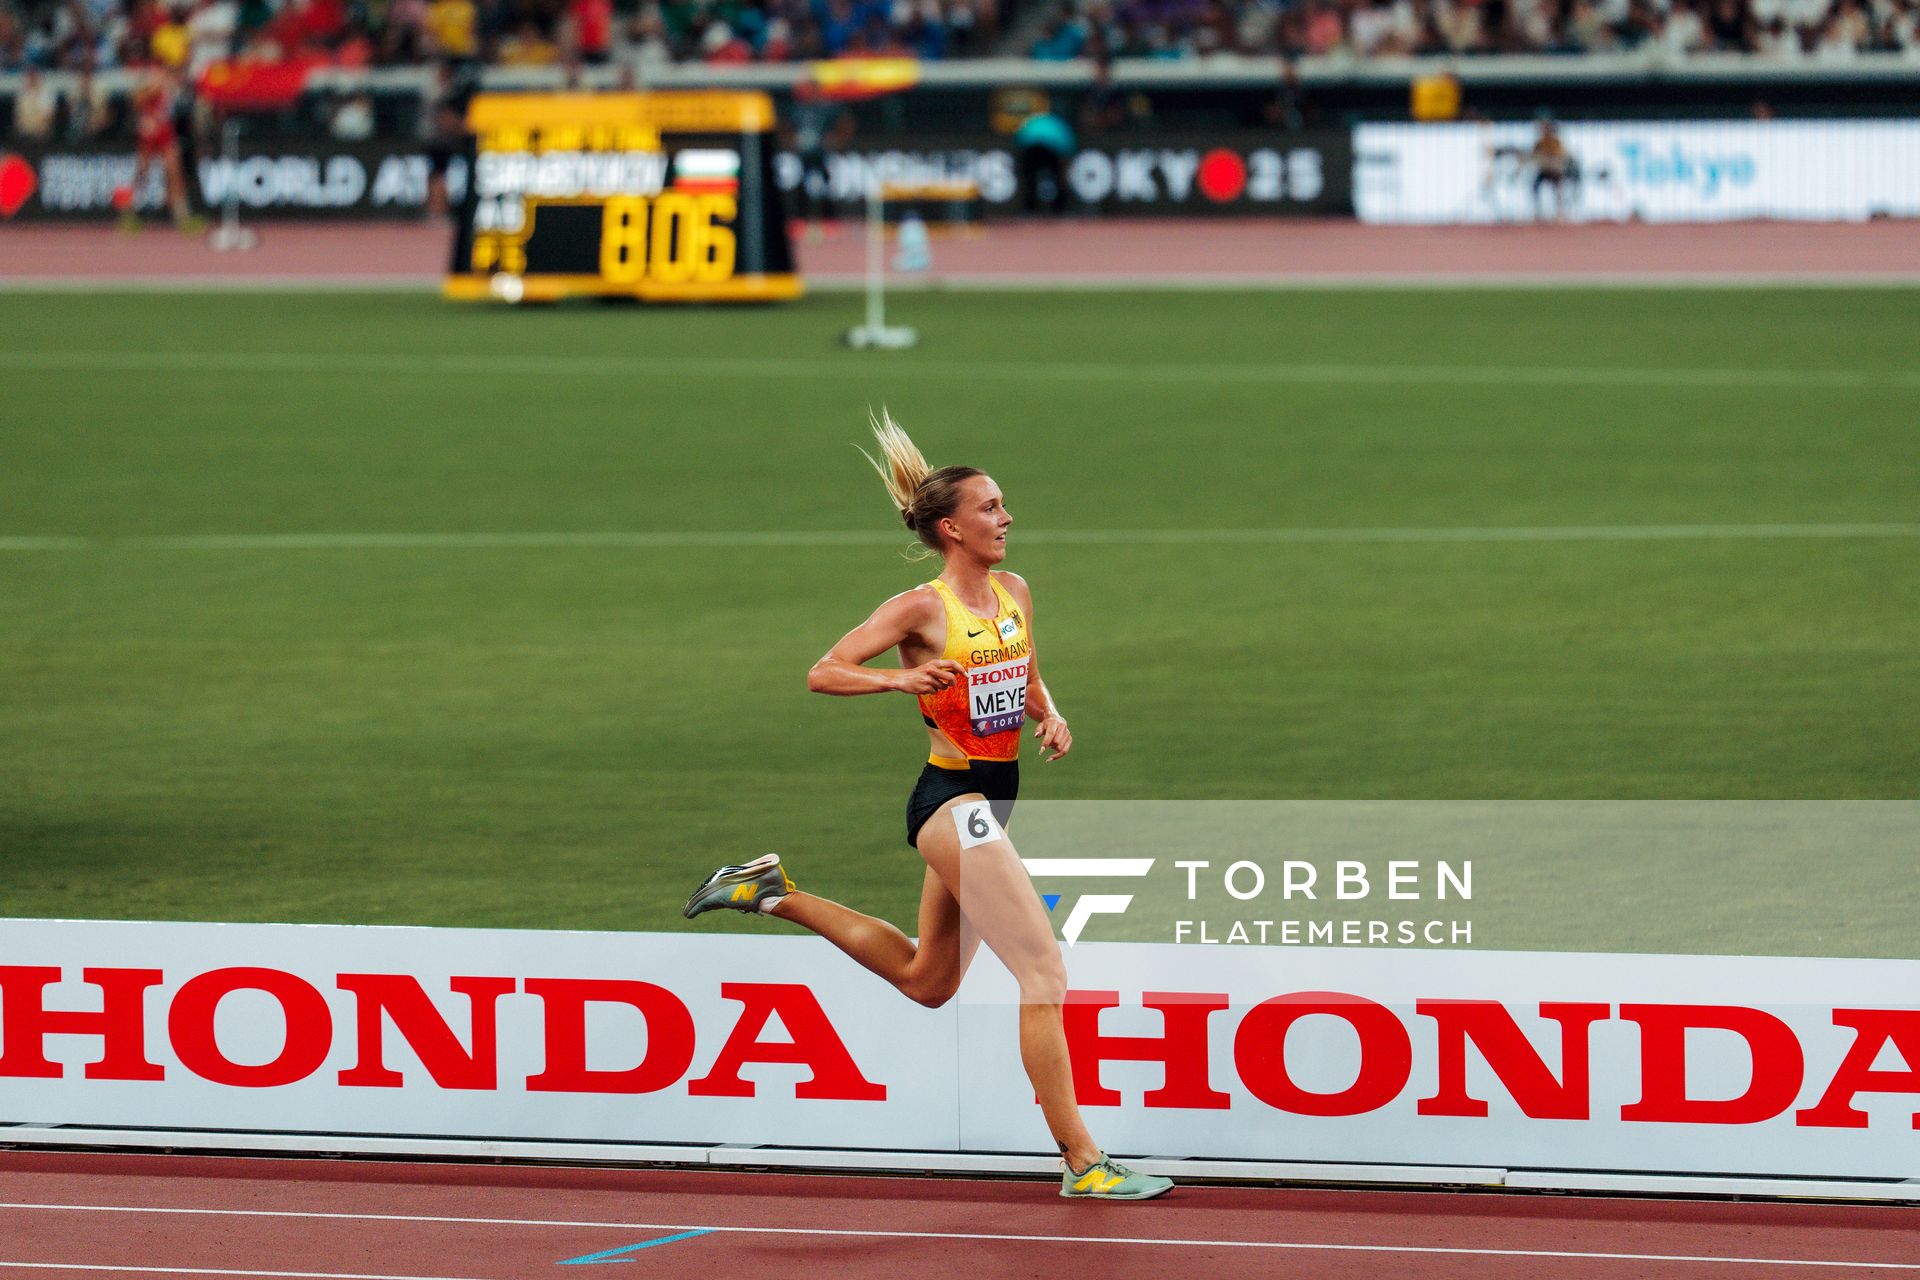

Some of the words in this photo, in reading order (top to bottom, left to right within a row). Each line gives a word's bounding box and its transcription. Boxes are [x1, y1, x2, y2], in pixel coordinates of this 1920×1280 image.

[197, 154, 368, 206] WORLD
[971, 665, 1028, 686] HOND
[968, 808, 990, 838] 6
[0, 965, 887, 1101] HONDA
[1035, 989, 1920, 1130] HONDA
